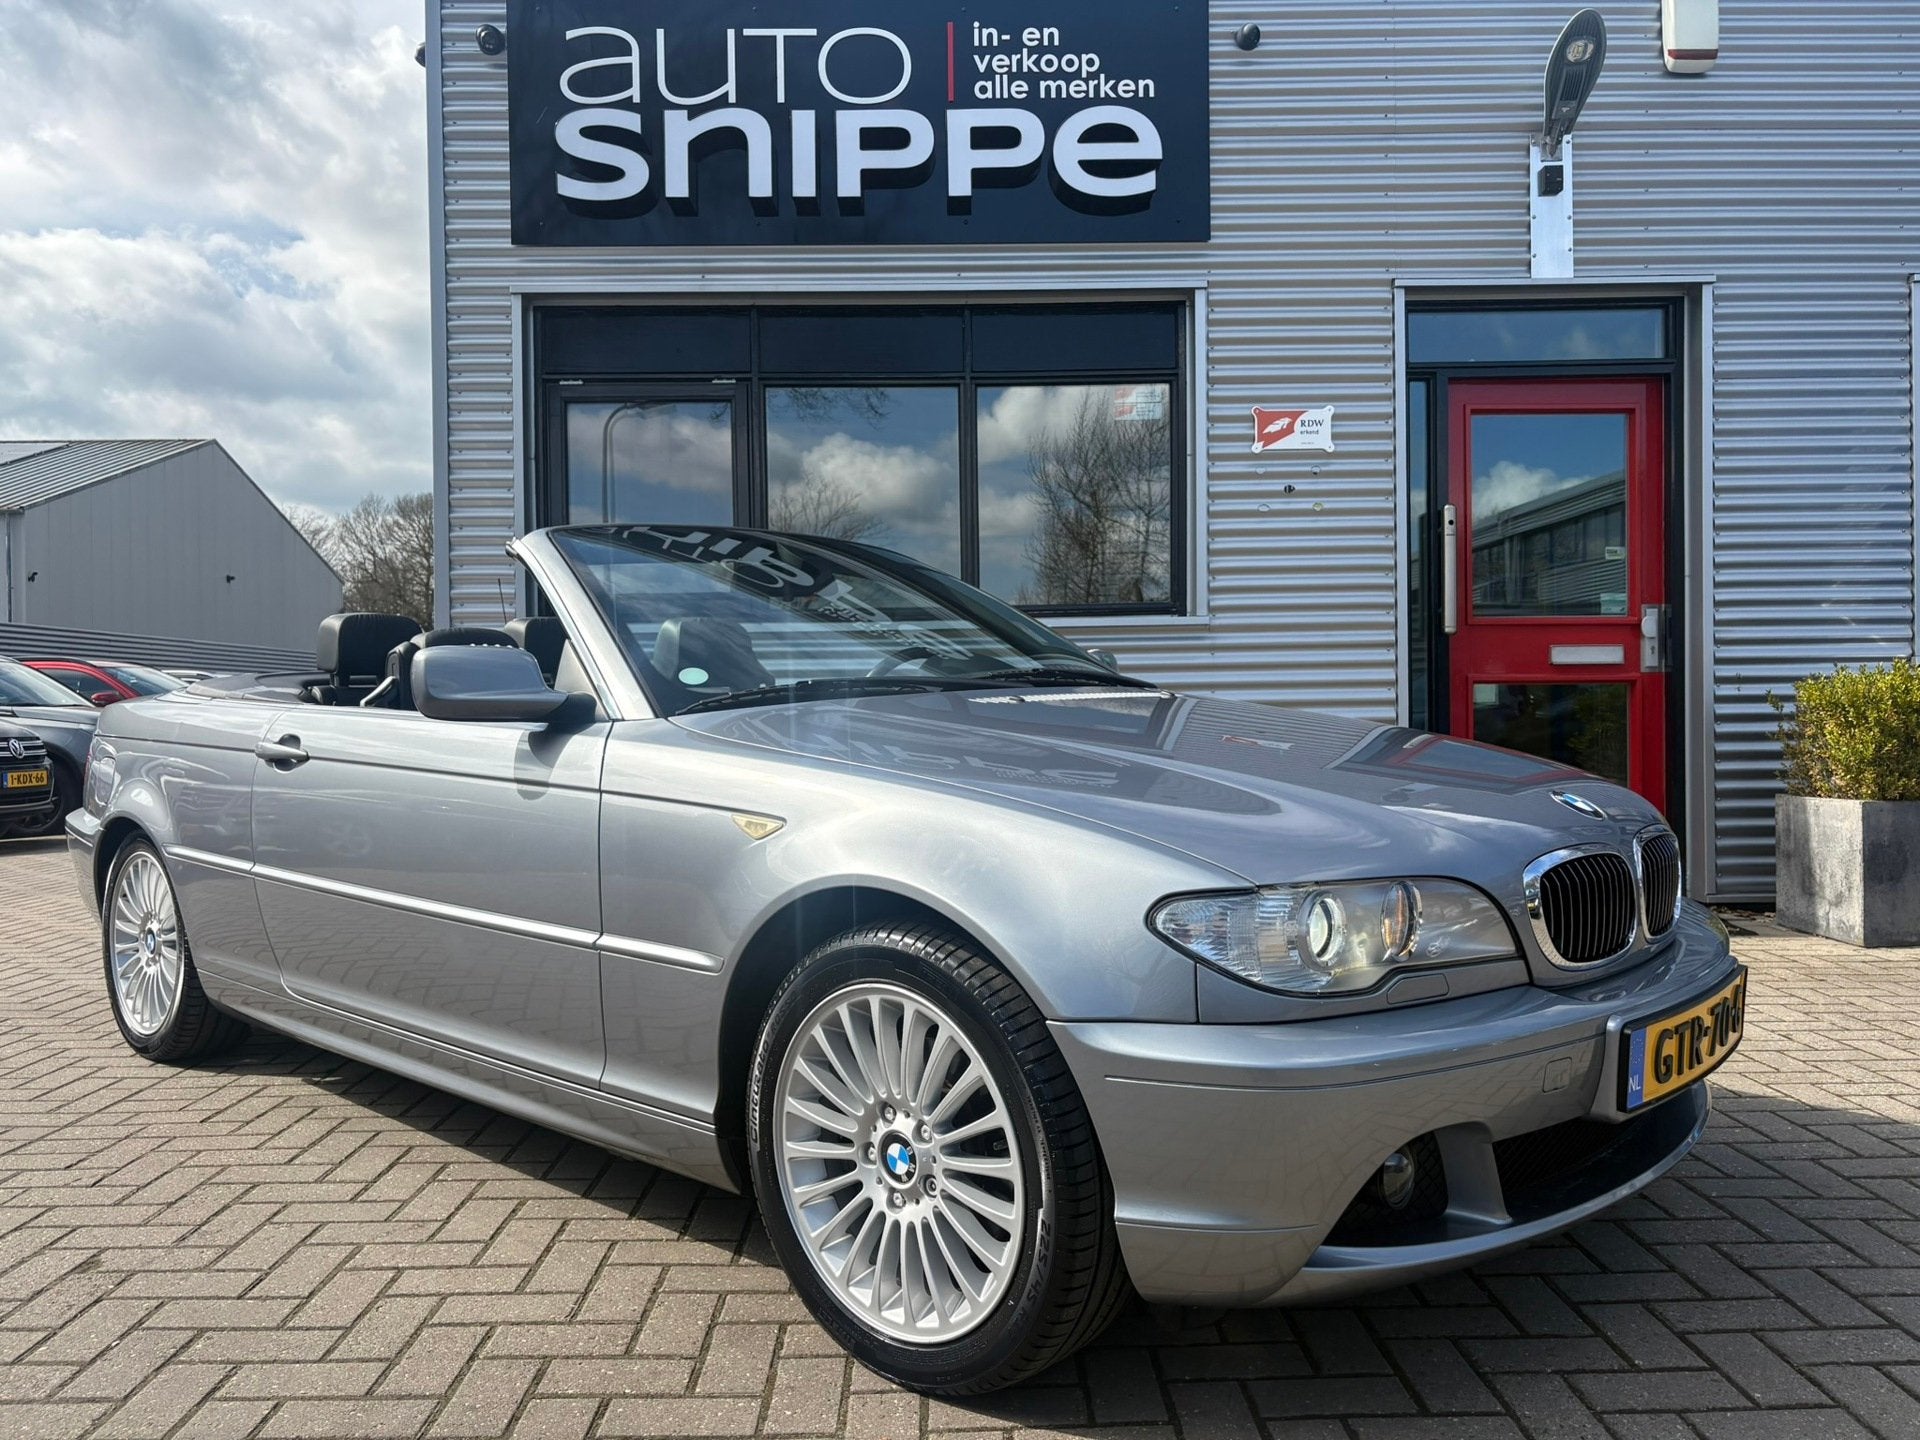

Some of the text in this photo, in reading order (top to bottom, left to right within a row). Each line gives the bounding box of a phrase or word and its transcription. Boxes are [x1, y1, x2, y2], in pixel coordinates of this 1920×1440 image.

[973, 21, 1060, 47] in- en
[973, 48, 1100, 78] verkoop
[974, 73, 1155, 99] alle merken
[1300, 419, 1324, 427] RDW
[10, 772, 45, 785] 1-KDX-66
[1628, 1076, 1641, 1093] NL
